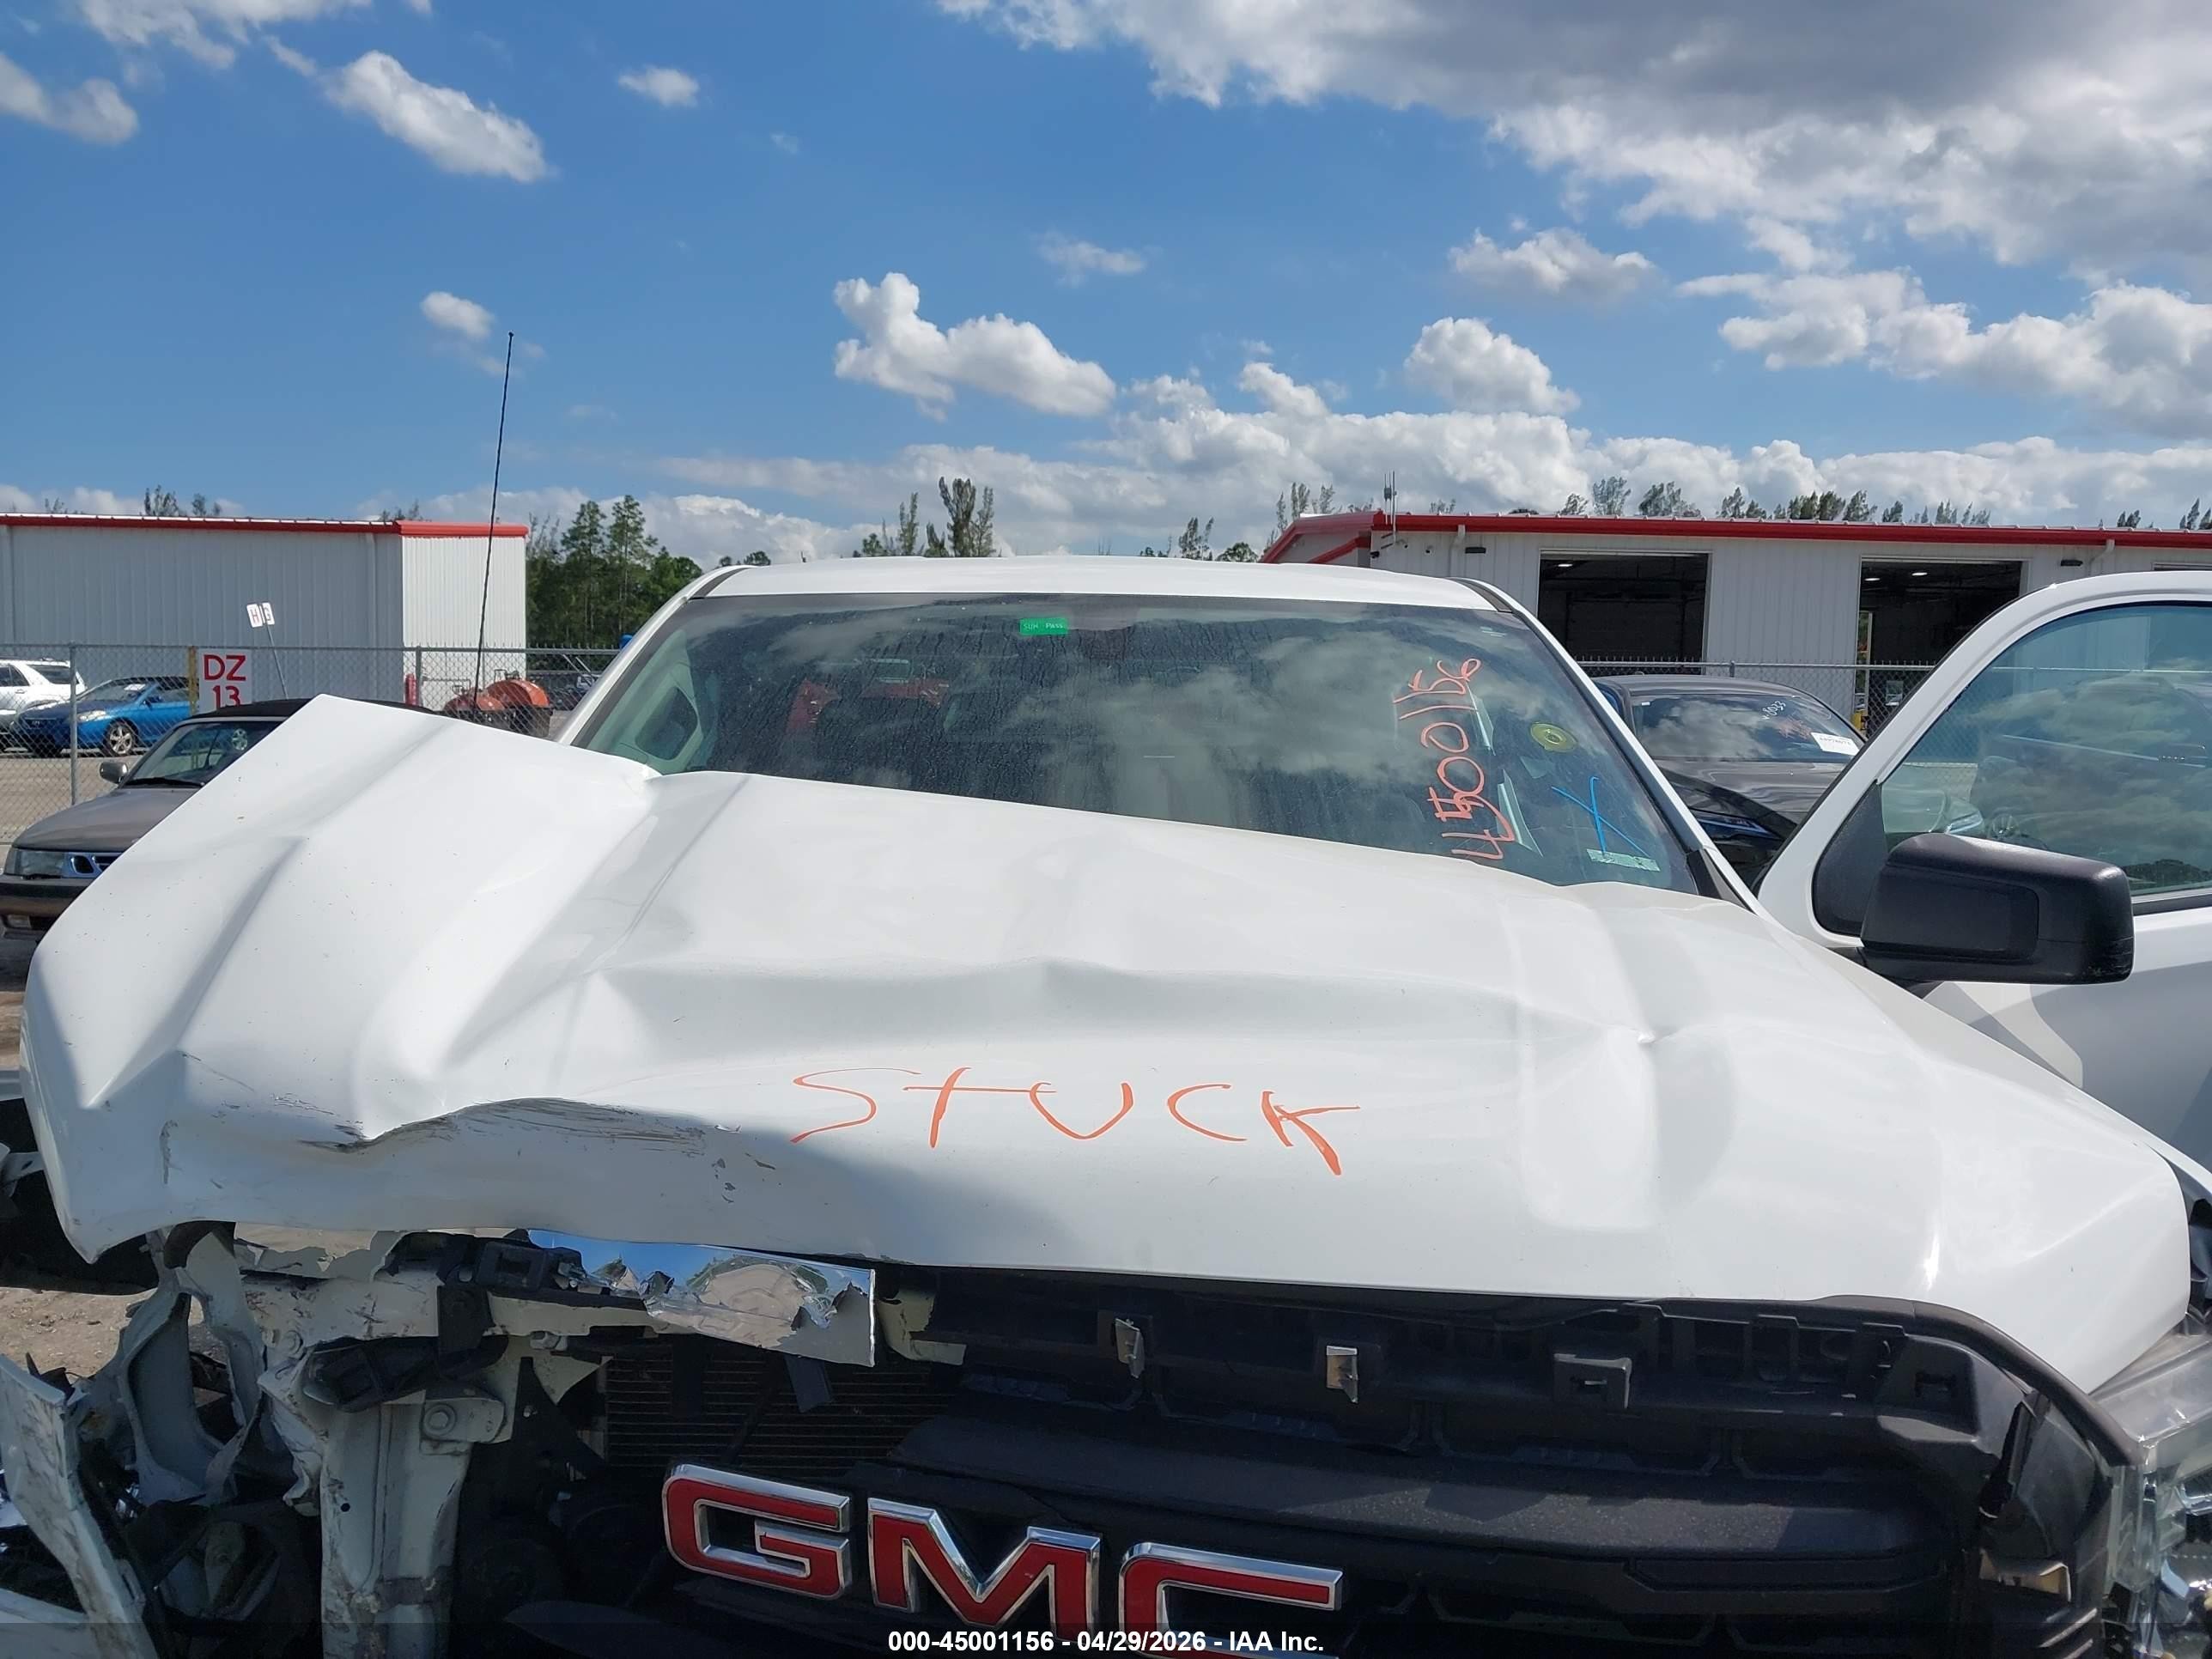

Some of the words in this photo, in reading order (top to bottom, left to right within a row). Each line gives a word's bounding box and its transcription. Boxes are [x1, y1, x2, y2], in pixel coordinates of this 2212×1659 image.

[204, 654, 246, 681] DZ
[212, 685, 241, 709] 13
[662, 1463, 1344, 1659] GMC
